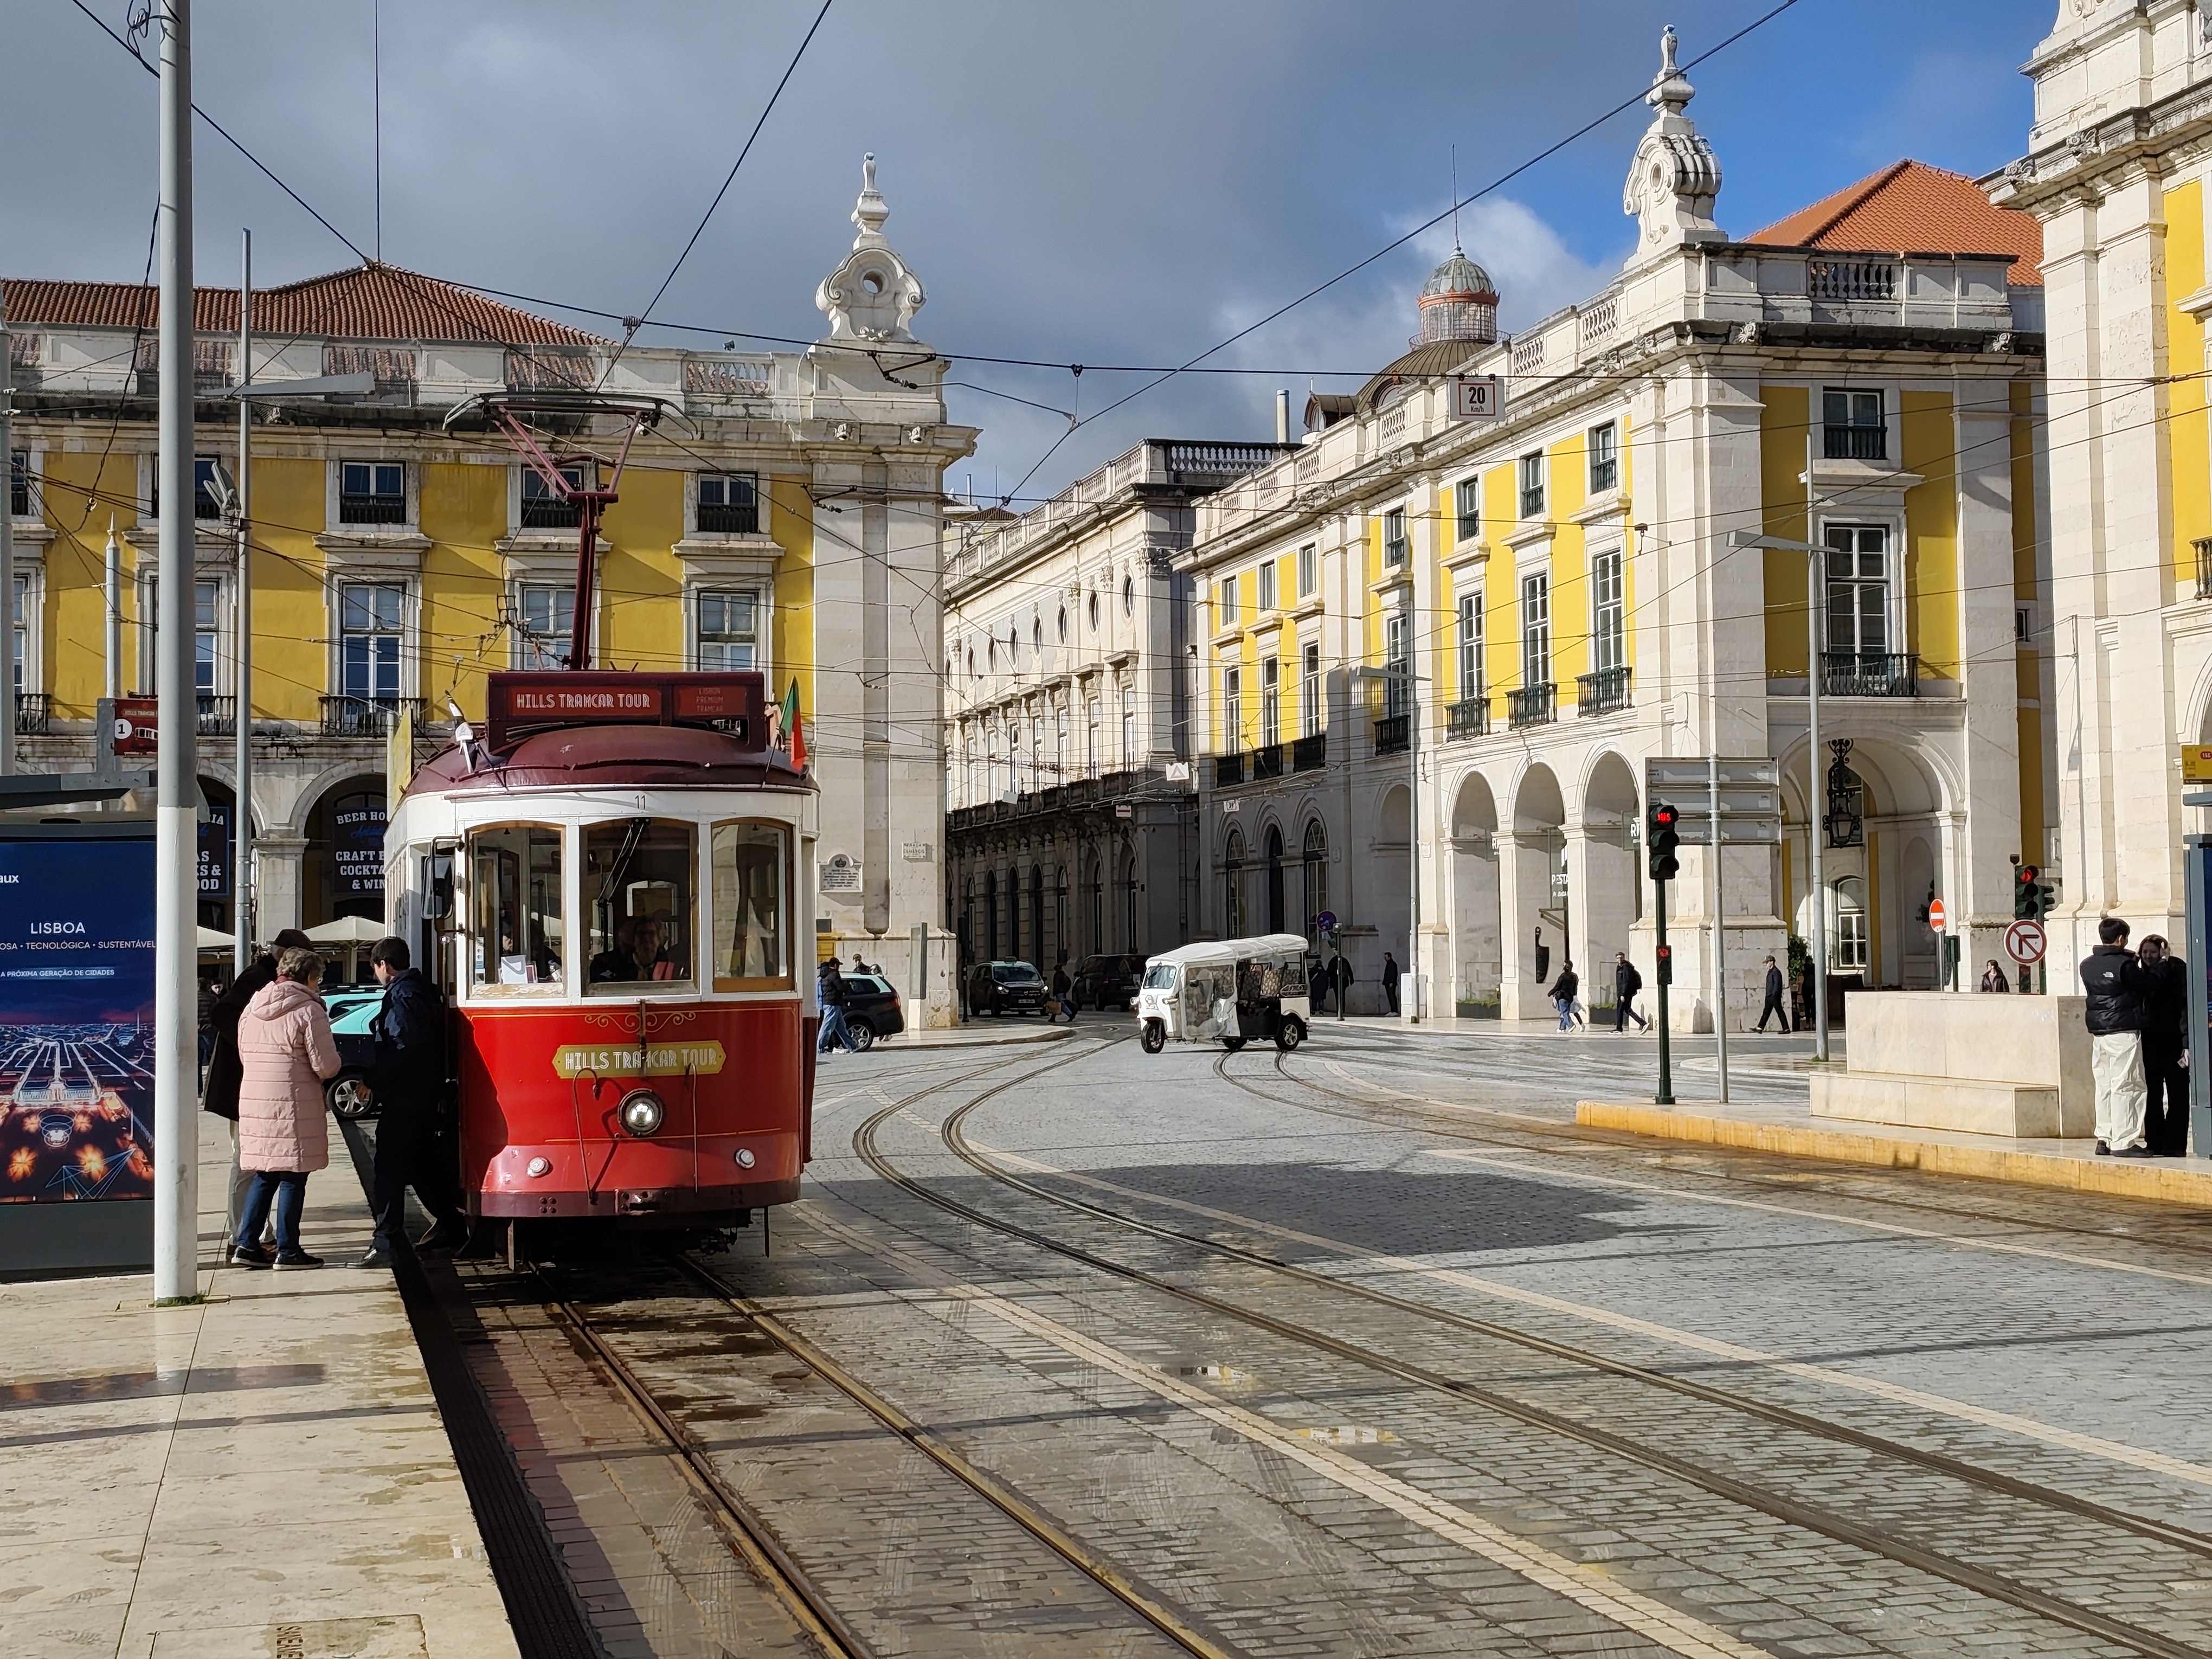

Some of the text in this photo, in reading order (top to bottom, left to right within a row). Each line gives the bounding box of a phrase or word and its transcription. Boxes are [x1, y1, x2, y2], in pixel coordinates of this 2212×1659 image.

[1468, 387, 1486, 404] 20
[517, 693, 650, 708] HILLS TRAMCAR TOUR
[118, 724, 125, 734] 1
[634, 795, 646, 809] 11
[336, 812, 367, 825] BEER
[336, 851, 376, 861] CRAFT
[211, 865, 222, 876] &
[352, 879, 361, 890] &
[30, 922, 86, 934] LISBOA
[25, 940, 91, 949] TECNOLÓGICA
[98, 939, 156, 949] SUSTENTÁVEL
[40, 969, 73, 978] GERAÇÃO
[565, 1051, 609, 1070] HILLS
[681, 1048, 717, 1066] TOUR
